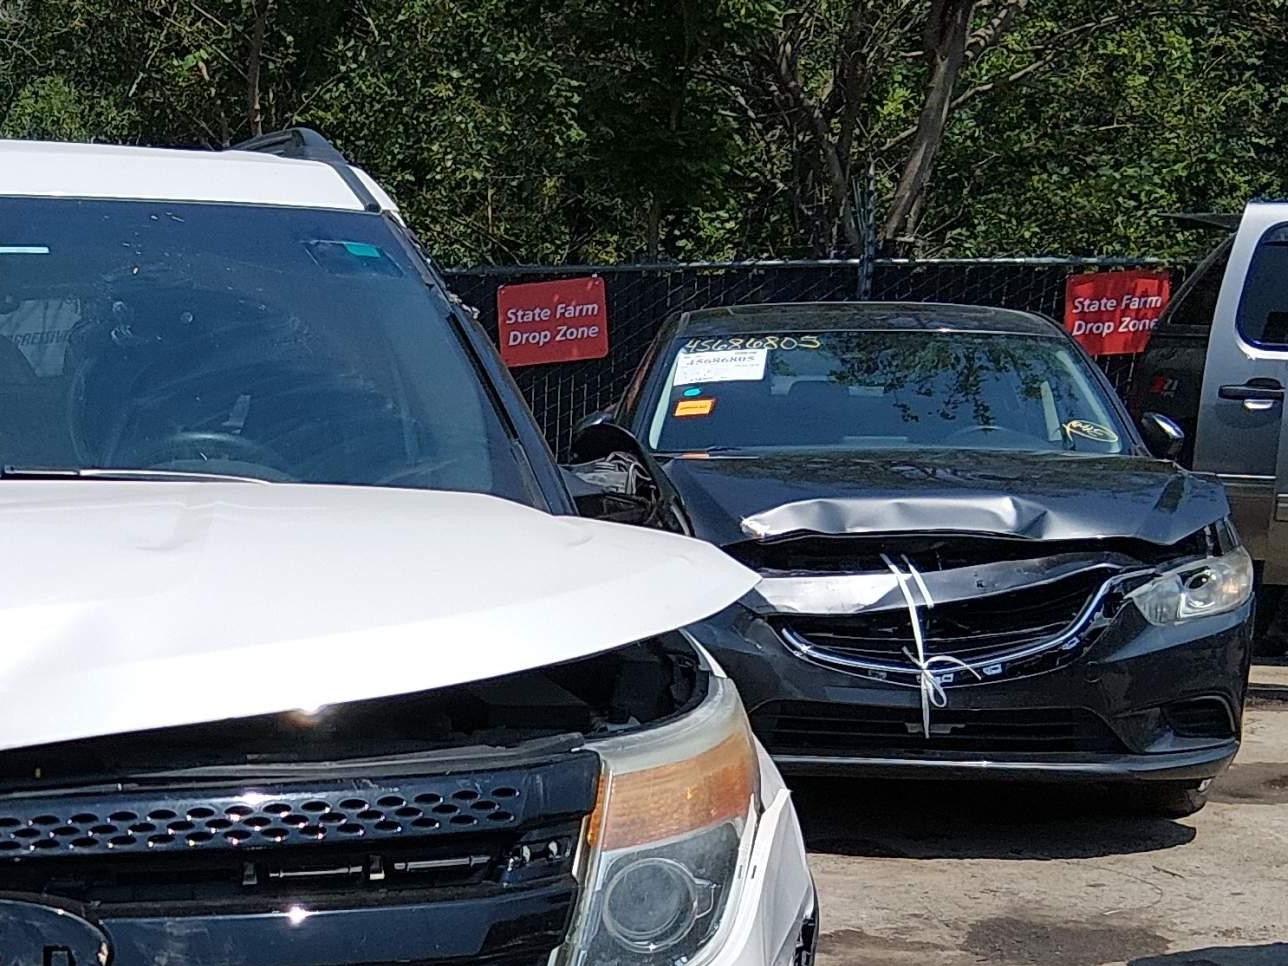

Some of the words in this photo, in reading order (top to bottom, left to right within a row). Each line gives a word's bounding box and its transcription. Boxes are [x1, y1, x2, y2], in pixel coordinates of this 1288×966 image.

[506, 307, 551, 324] State
[556, 303, 598, 319] Farm
[1072, 297, 1117, 314] State
[1121, 294, 1162, 310] Farm
[508, 330, 551, 346] Drop
[555, 325, 599, 341] Zone
[1072, 319, 1114, 337] Drop
[1118, 316, 1159, 332] Zone
